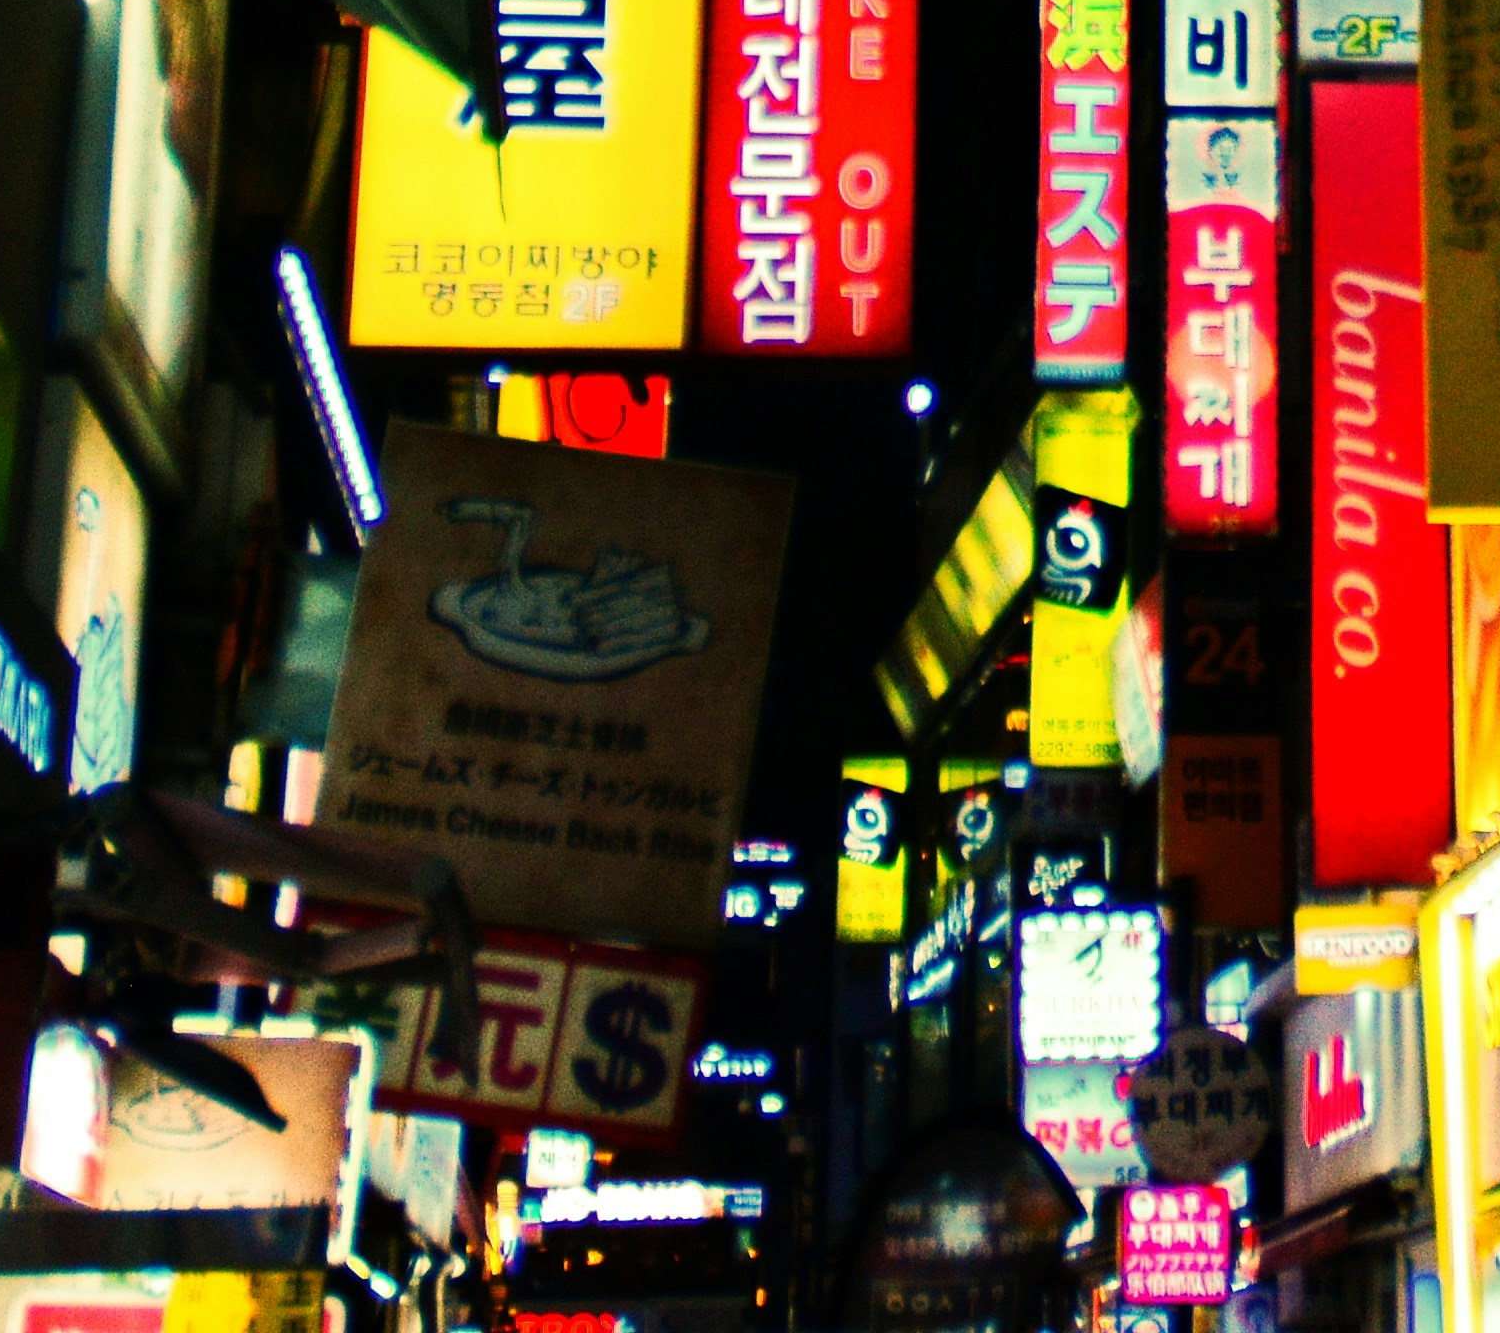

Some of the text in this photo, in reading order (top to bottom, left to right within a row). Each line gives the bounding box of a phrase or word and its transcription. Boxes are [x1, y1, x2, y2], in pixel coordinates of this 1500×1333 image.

[837, 153, 891, 337] OUT
[1177, 226, 1257, 509] 부대찌개
[1331, 265, 1425, 680] banila co.
[570, 980, 672, 1114] $
